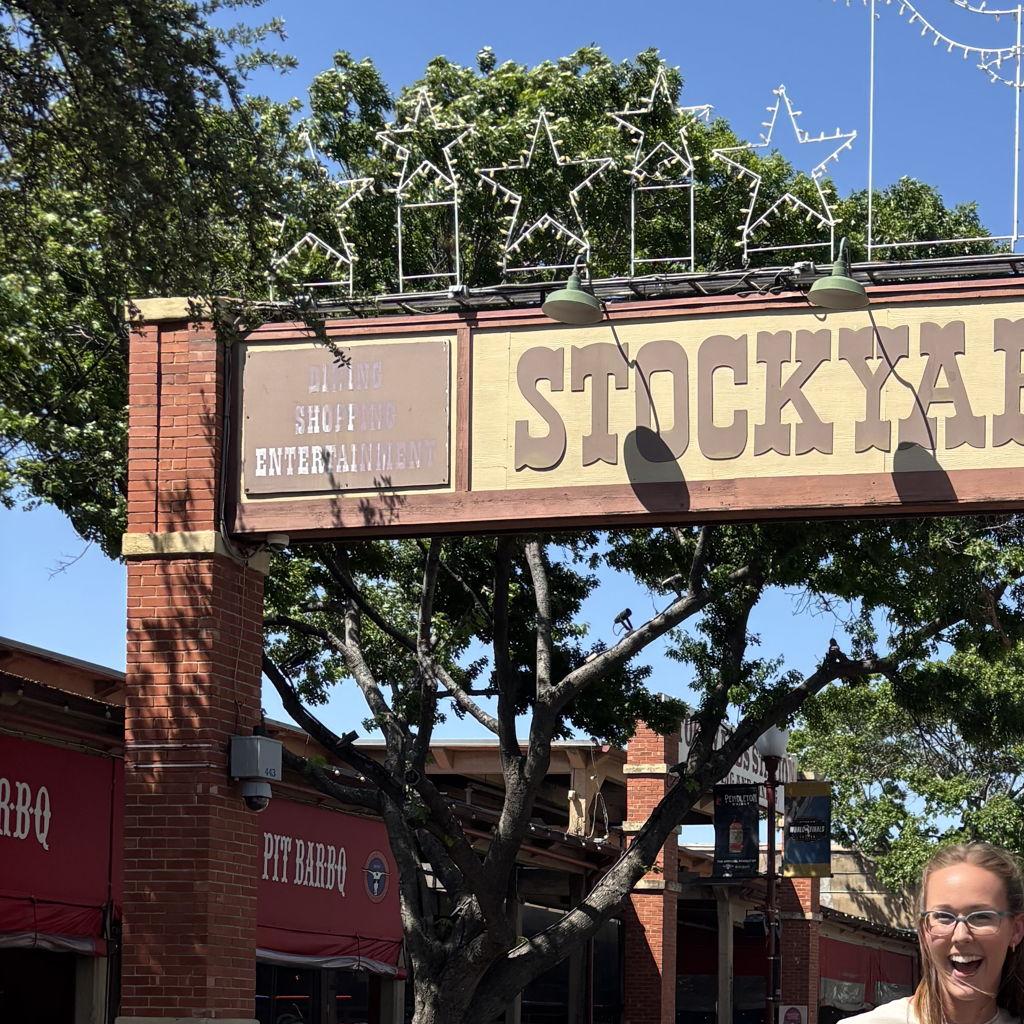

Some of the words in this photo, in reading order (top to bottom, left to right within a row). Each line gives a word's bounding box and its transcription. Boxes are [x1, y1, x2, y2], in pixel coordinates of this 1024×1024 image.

[294, 401, 396, 435] SHOPPING
[255, 440, 437, 477] ENTERTAINMENT
[264, 767, 276, 778] 443
[724, 793, 758, 804] PENDLETON
[262, 832, 292, 883] PIT
